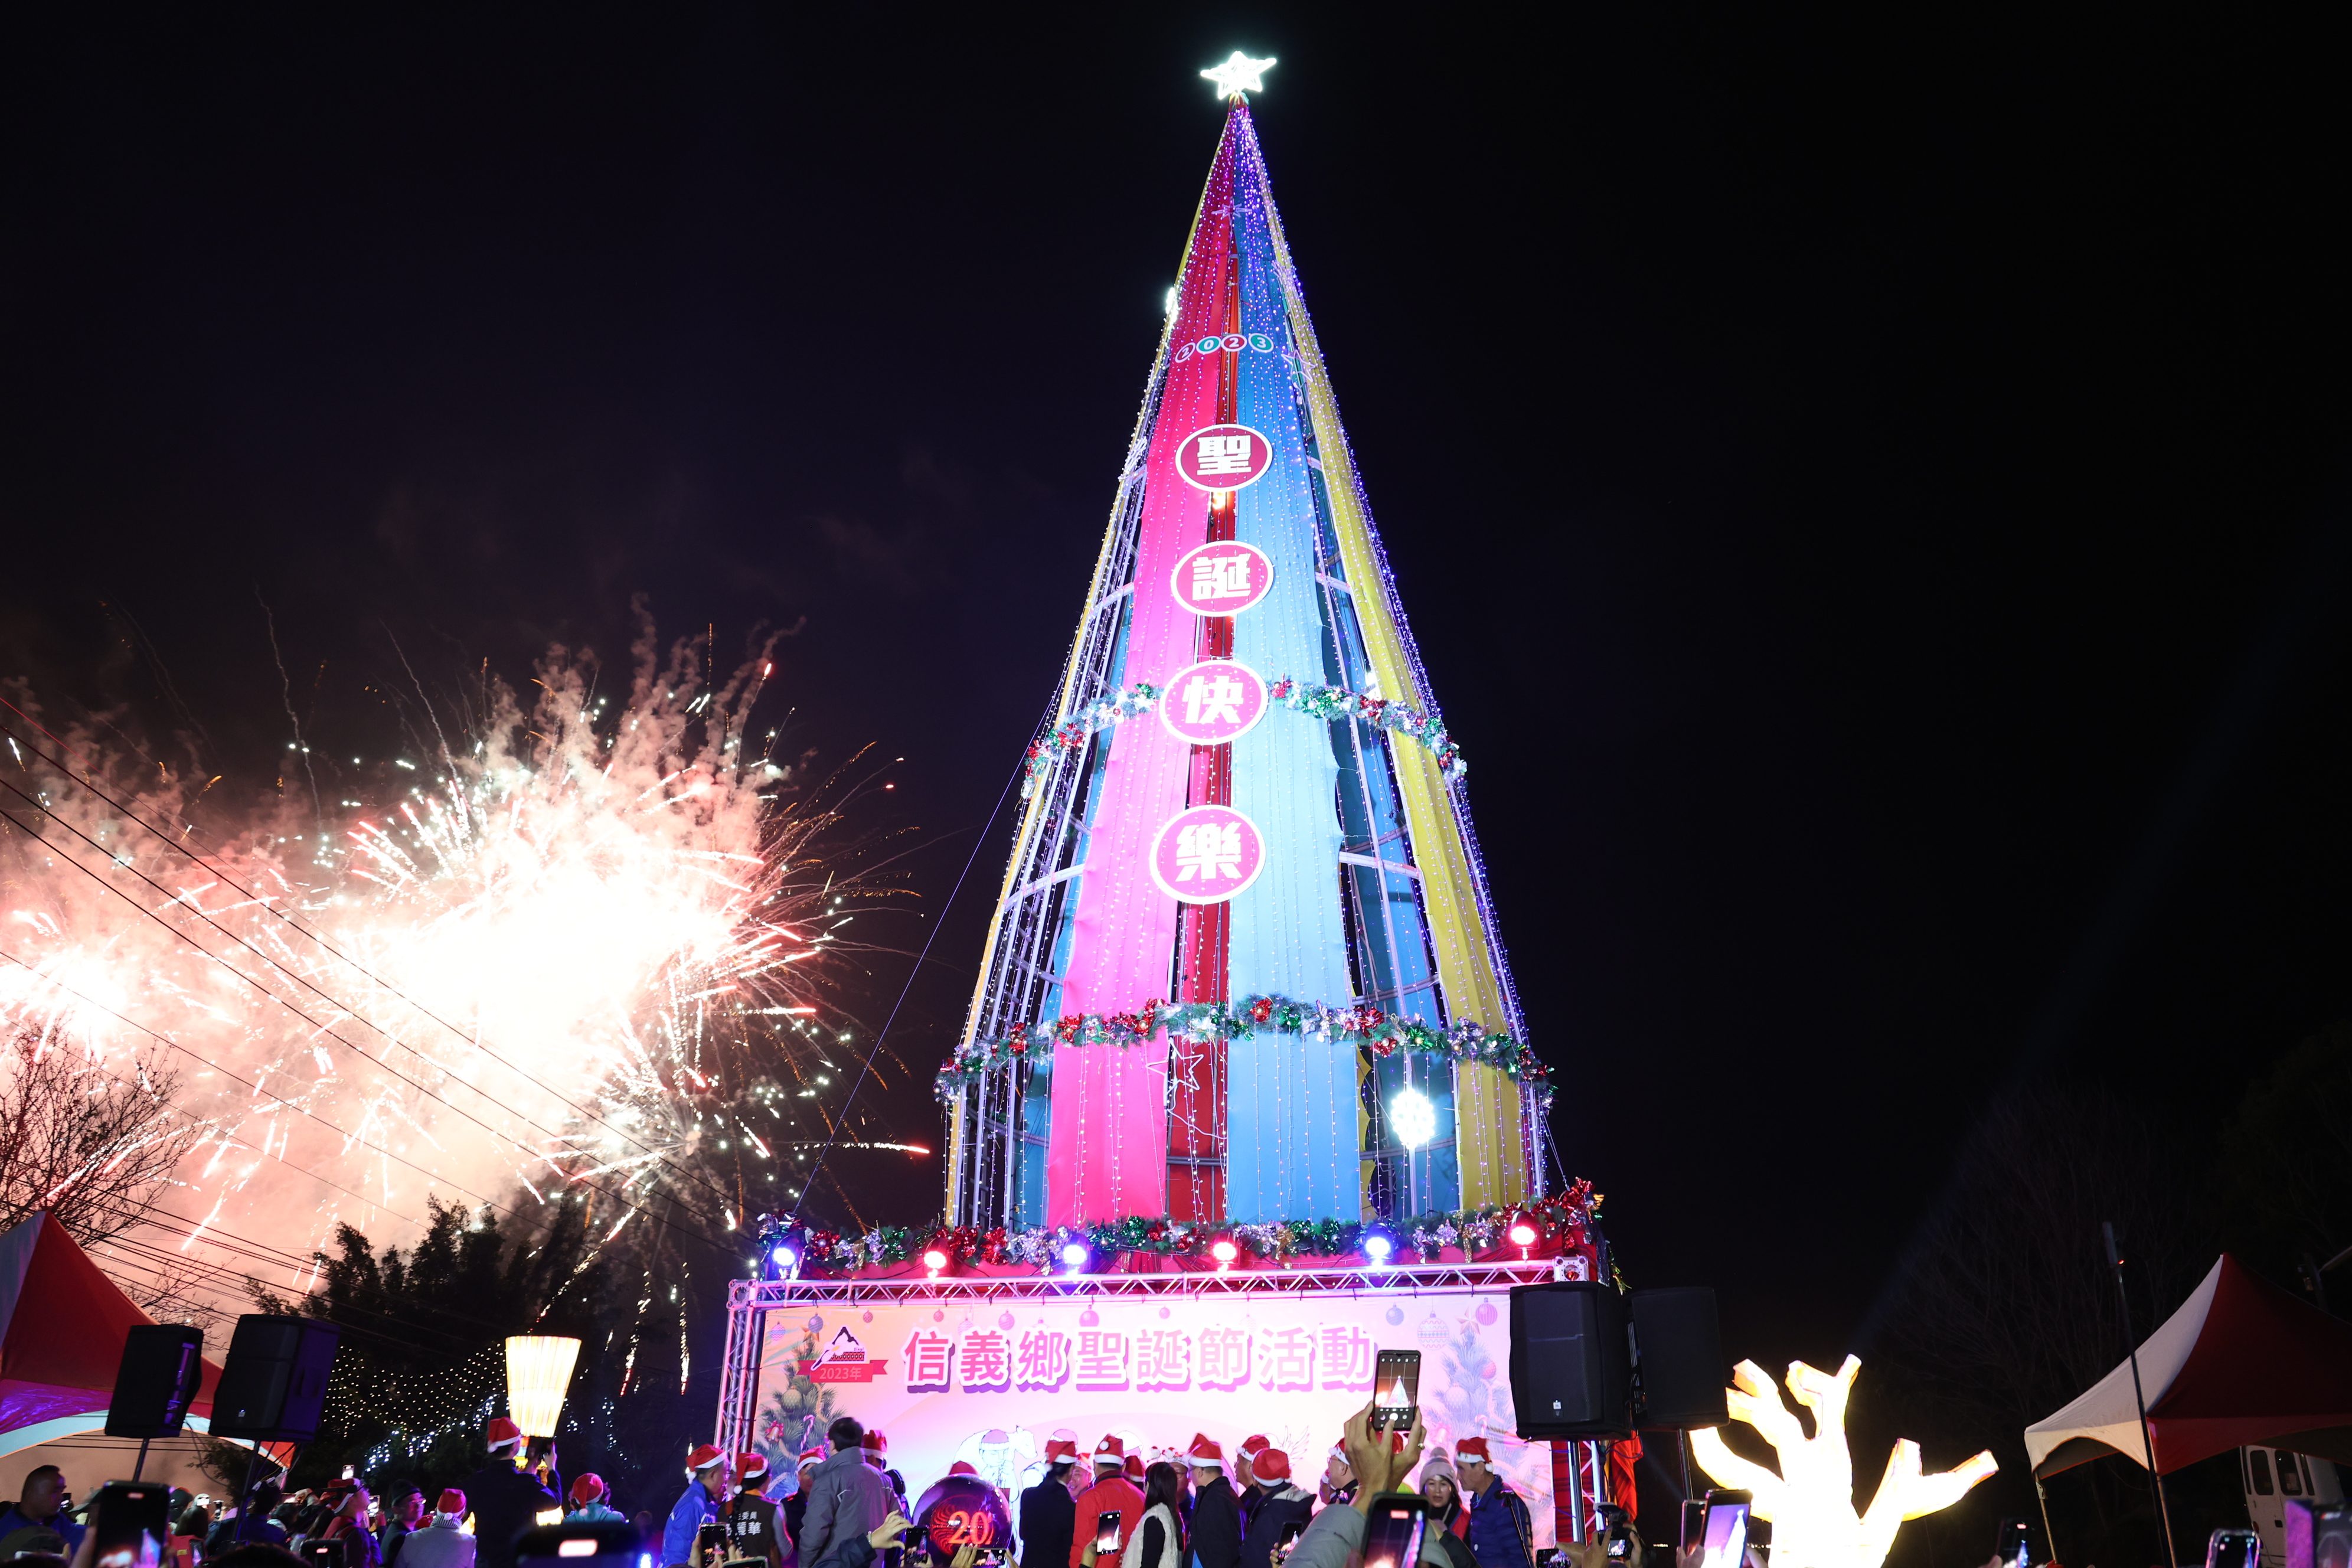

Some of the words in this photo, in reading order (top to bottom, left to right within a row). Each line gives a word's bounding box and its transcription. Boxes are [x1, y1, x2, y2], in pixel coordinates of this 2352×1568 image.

[1180, 335, 1268, 357] 2023
[1175, 435, 1252, 883] 聖誕快樂
[819, 1367, 862, 1380] 2023年
[904, 1326, 1370, 1382] 信義鄉聖誕節活動
